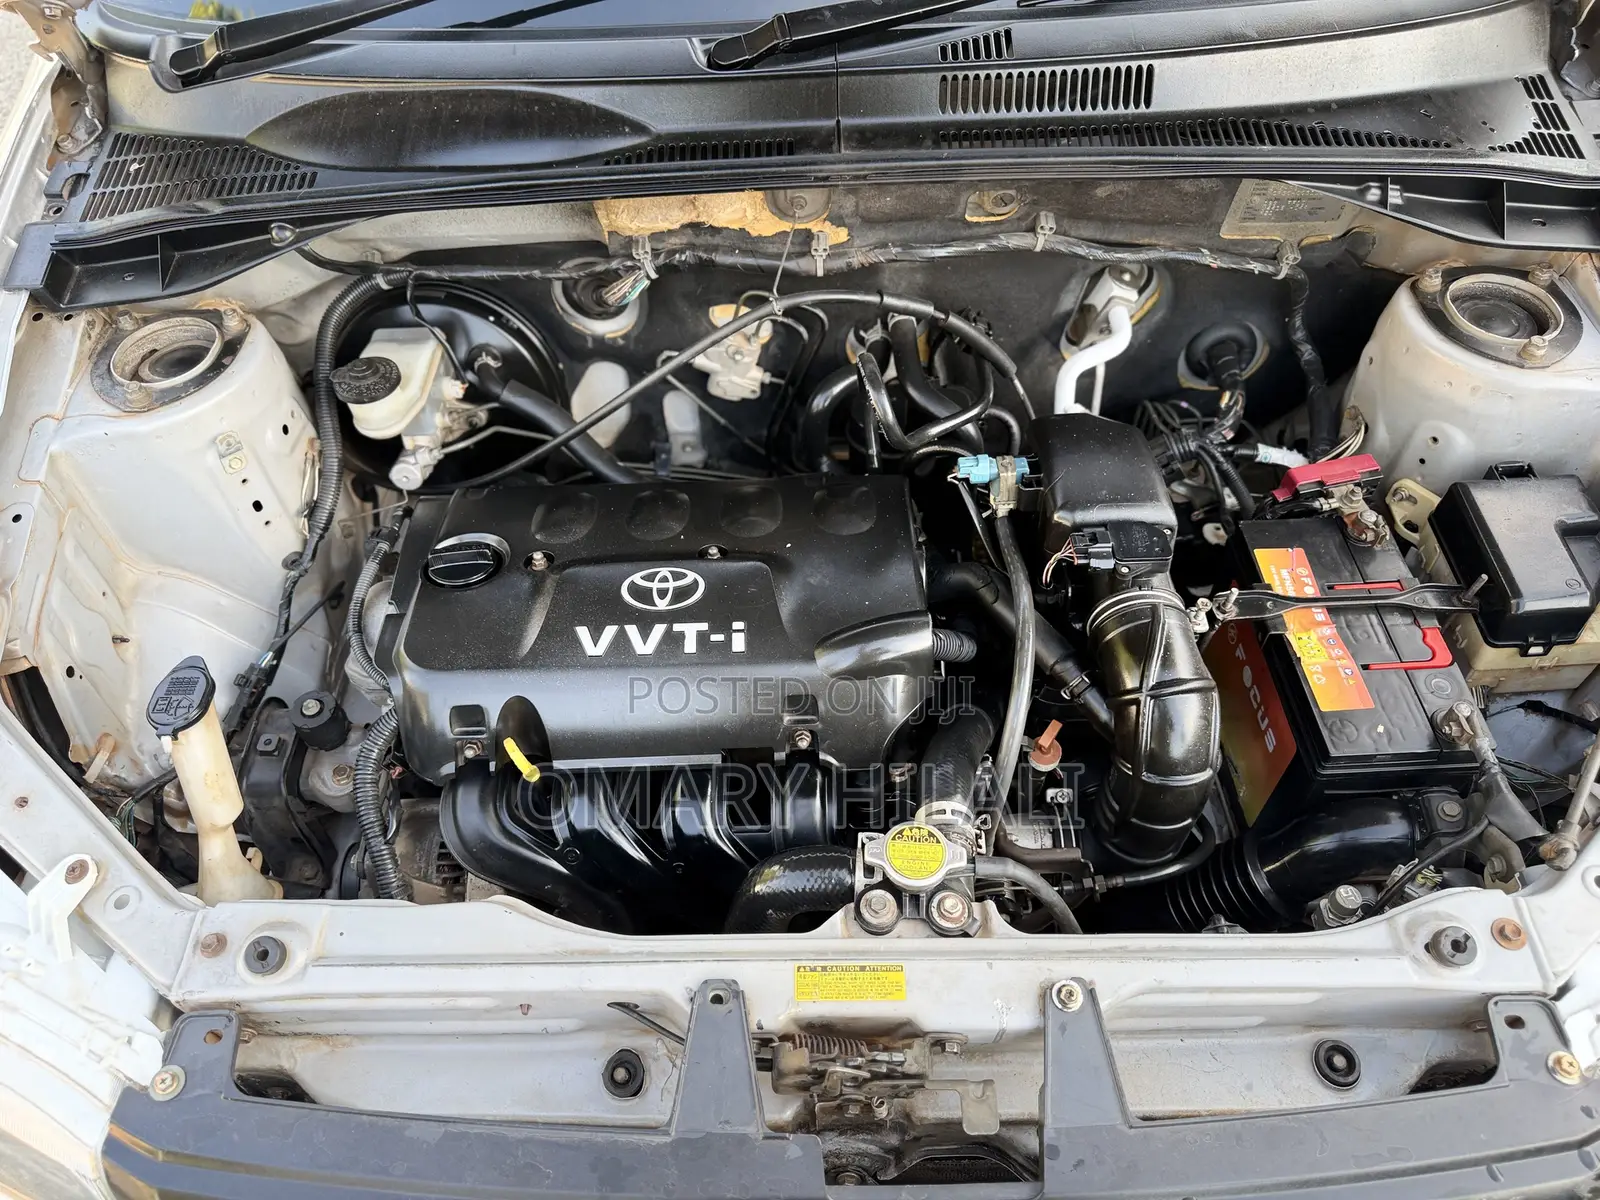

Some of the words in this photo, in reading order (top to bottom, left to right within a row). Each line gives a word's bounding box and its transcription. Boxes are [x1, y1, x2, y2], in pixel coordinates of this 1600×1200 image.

[1300, 577, 1326, 622] FOUS
[574, 621, 746, 657] VVT-i
[1235, 643, 1276, 753] FOCUS
[895, 834, 937, 844] CAUTION
